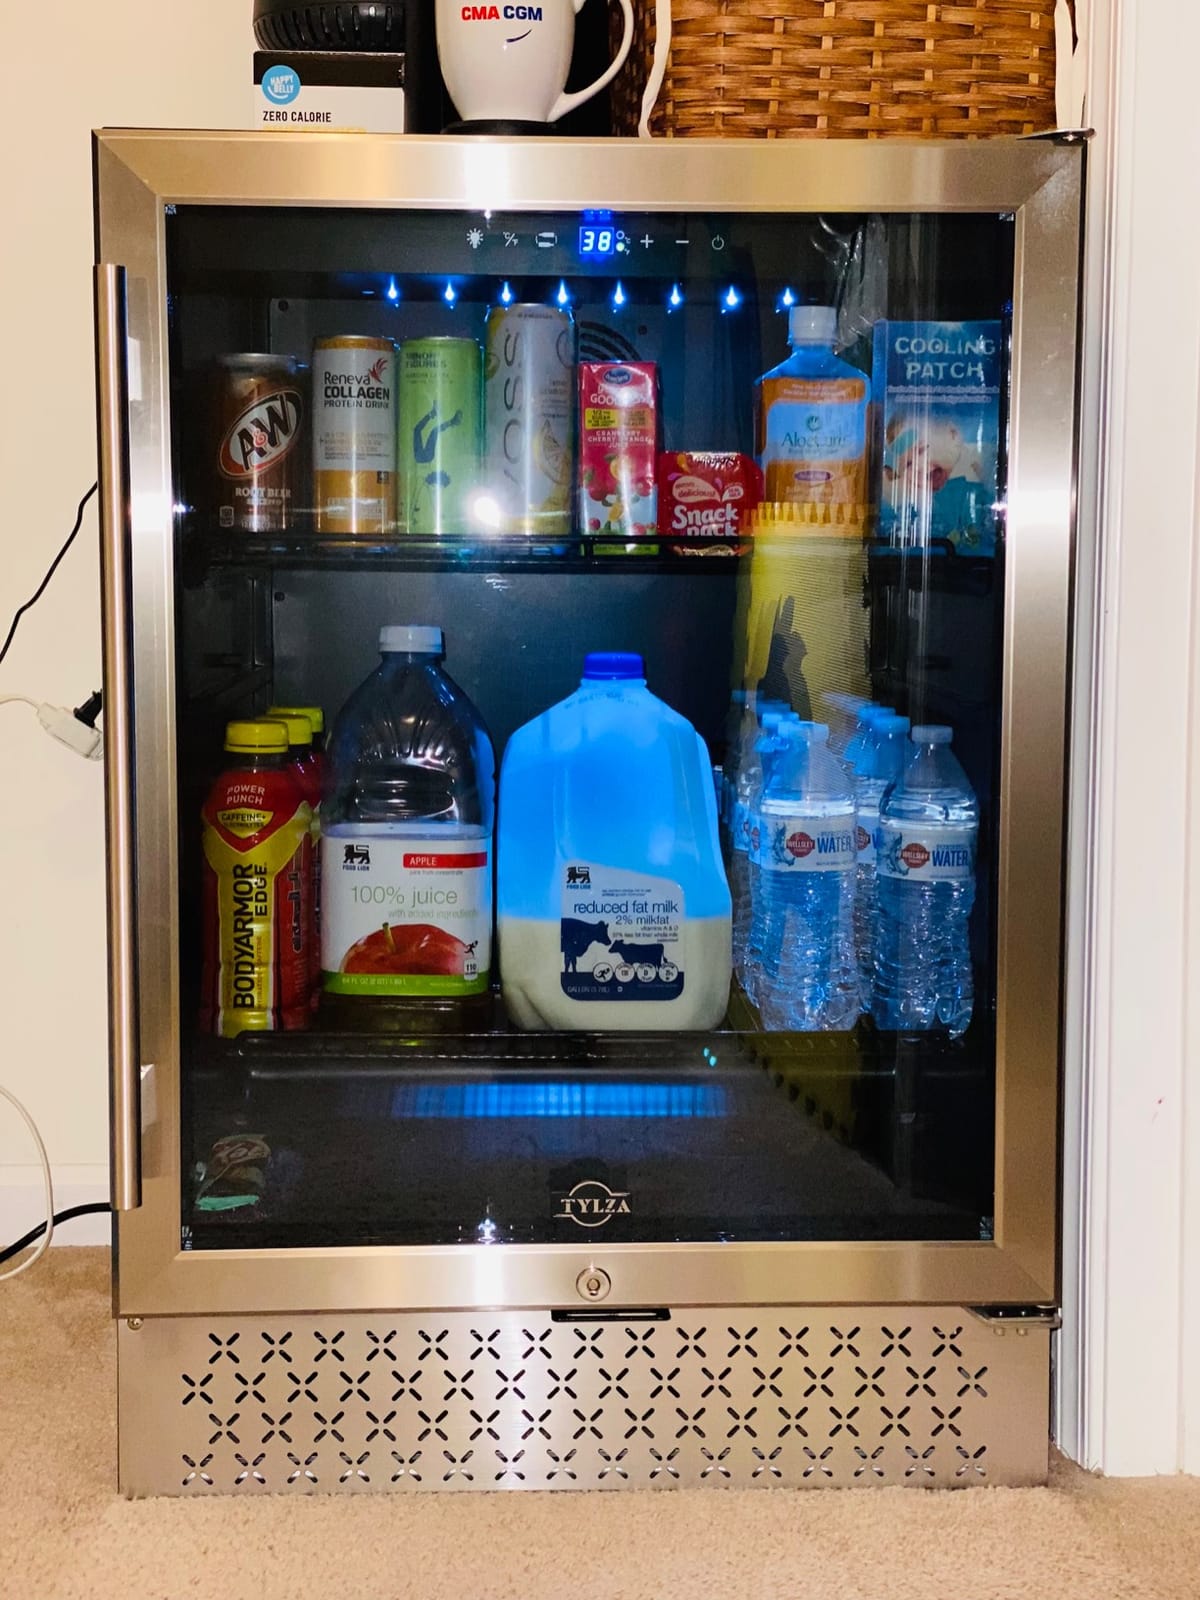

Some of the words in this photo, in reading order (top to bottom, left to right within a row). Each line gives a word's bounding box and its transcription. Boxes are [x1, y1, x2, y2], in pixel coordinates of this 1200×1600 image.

[461, 6, 500, 21] CMA
[503, 5, 543, 21] CGM
[270, 74, 294, 86] HAPPY
[273, 83, 294, 93] BELLY
[263, 110, 288, 122] ZERO
[291, 111, 332, 123] CALORIE
[582, 230, 612, 252] 38
[894, 337, 996, 355] COOLING
[905, 361, 982, 380] PATCH
[324, 371, 370, 385] Reneva
[324, 385, 390, 400] COLLAGEN
[324, 400, 363, 408] PROTEIN
[365, 401, 389, 409] DRINK
[237, 391, 292, 471] A&W
[235, 487, 265, 497] ROOT
[672, 503, 739, 529] Snack
[227, 784, 265, 795] POWER
[226, 794, 263, 805] PUNCH
[817, 835, 851, 854] WATER
[409, 856, 437, 866] APPLE
[932, 850, 969, 867] WATER
[254, 864, 267, 917] EDGE
[352, 885, 405, 904] 100%
[411, 886, 458, 908] juice
[574, 900, 628, 914] reduced
[632, 900, 648, 914] fat
[652, 900, 679, 914] milk
[615, 915, 633, 925] 2%
[636, 914, 670, 925] milkfat
[233, 863, 255, 1009] BODYARMOR
[560, 1199, 631, 1213] TYLZA
